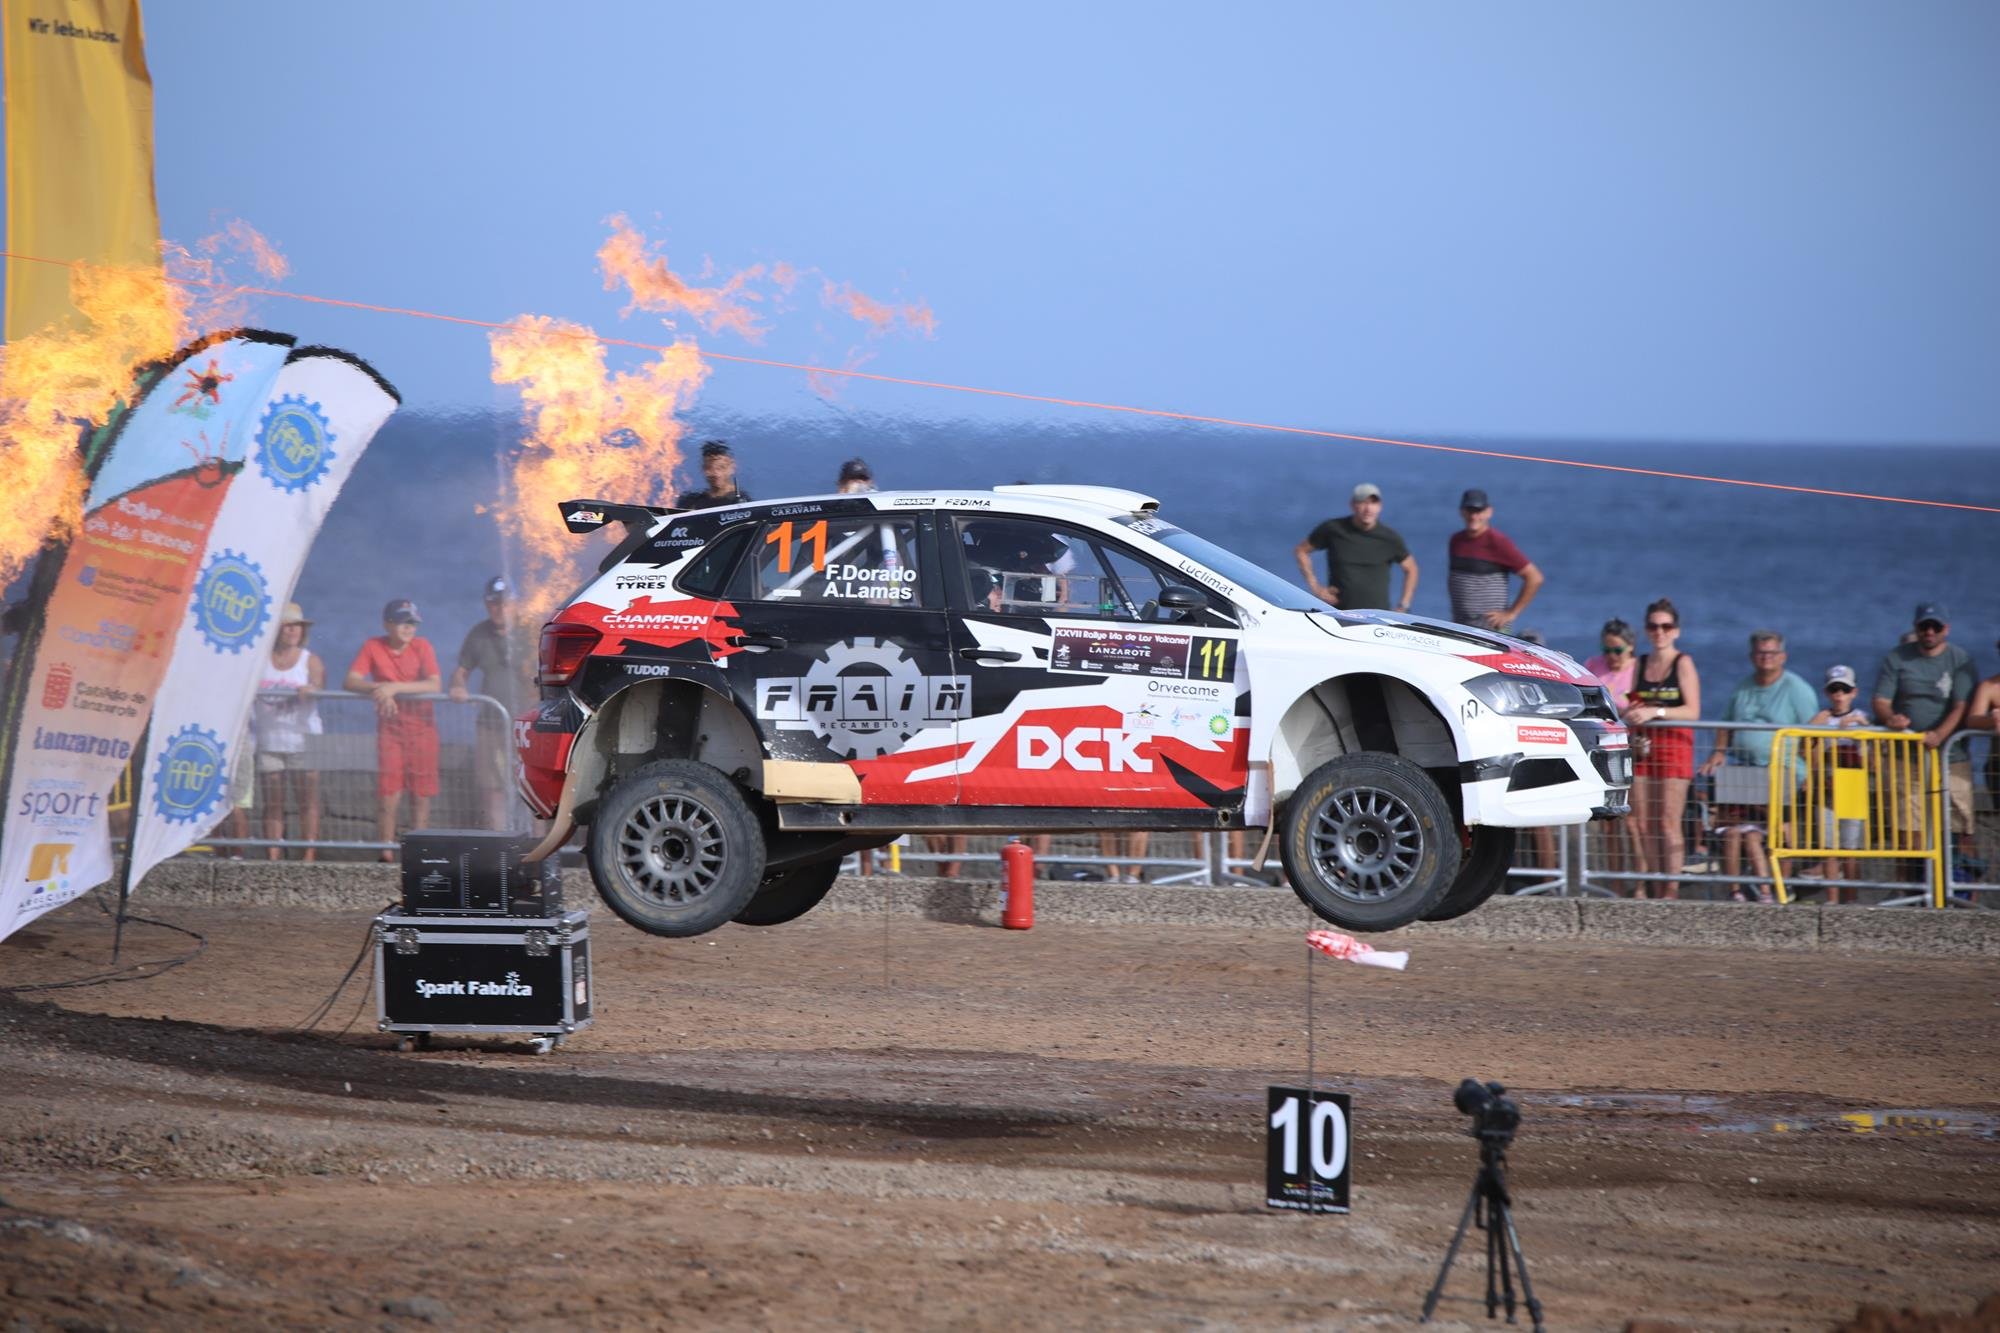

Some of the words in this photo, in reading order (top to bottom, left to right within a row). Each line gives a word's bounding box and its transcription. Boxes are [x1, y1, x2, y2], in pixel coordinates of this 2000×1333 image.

[771, 504, 822, 517] CARAVANA
[945, 499, 991, 507] FEDIMA
[766, 520, 828, 573] 11
[826, 564, 917, 583] F.Dorado
[1178, 559, 1234, 596] Luclimat
[616, 581, 665, 590] TYRES
[823, 582, 913, 600] A.Lamas
[602, 614, 708, 625] CHAMPION
[1125, 633, 1136, 641] de
[1088, 647, 1152, 658] LANZAROTE
[1200, 639, 1227, 679] 11
[626, 664, 671, 676] TUDOR
[1147, 680, 1220, 697] Orvecame
[820, 721, 909, 729] RECAMBIOS
[1519, 729, 1566, 738] CHAMPION
[33, 726, 130, 760] Lanzarote
[1017, 725, 1153, 773] DCK
[19, 791, 100, 823] sport
[416, 979, 466, 998] Spark
[467, 971, 533, 996] Fabrica
[1271, 1096, 1347, 1179] 10
